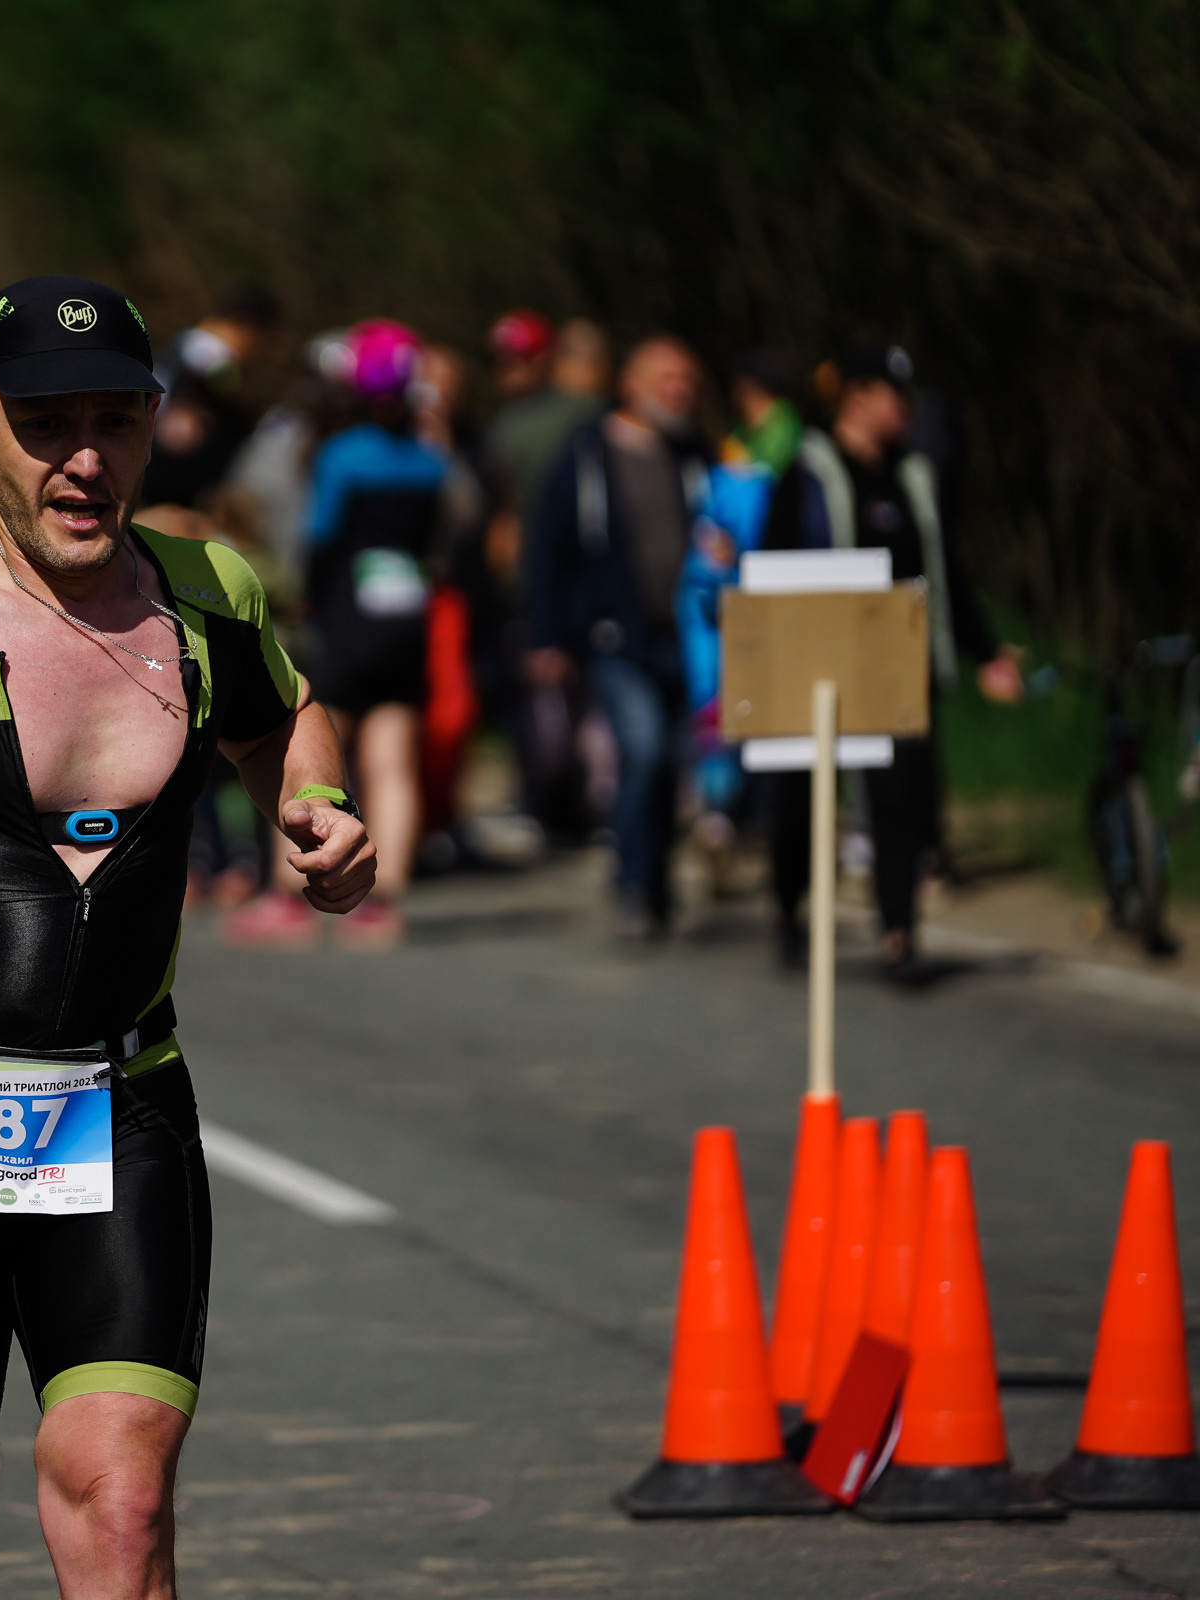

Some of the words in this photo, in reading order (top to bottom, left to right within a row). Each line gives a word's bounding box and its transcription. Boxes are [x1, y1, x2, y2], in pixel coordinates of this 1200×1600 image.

[62, 305, 93, 326] Buff
[177, 581, 228, 605] 2XU
[14, 1080, 71, 1092] ТРИАТЛОН
[73, 1077, 97, 1088] 2023
